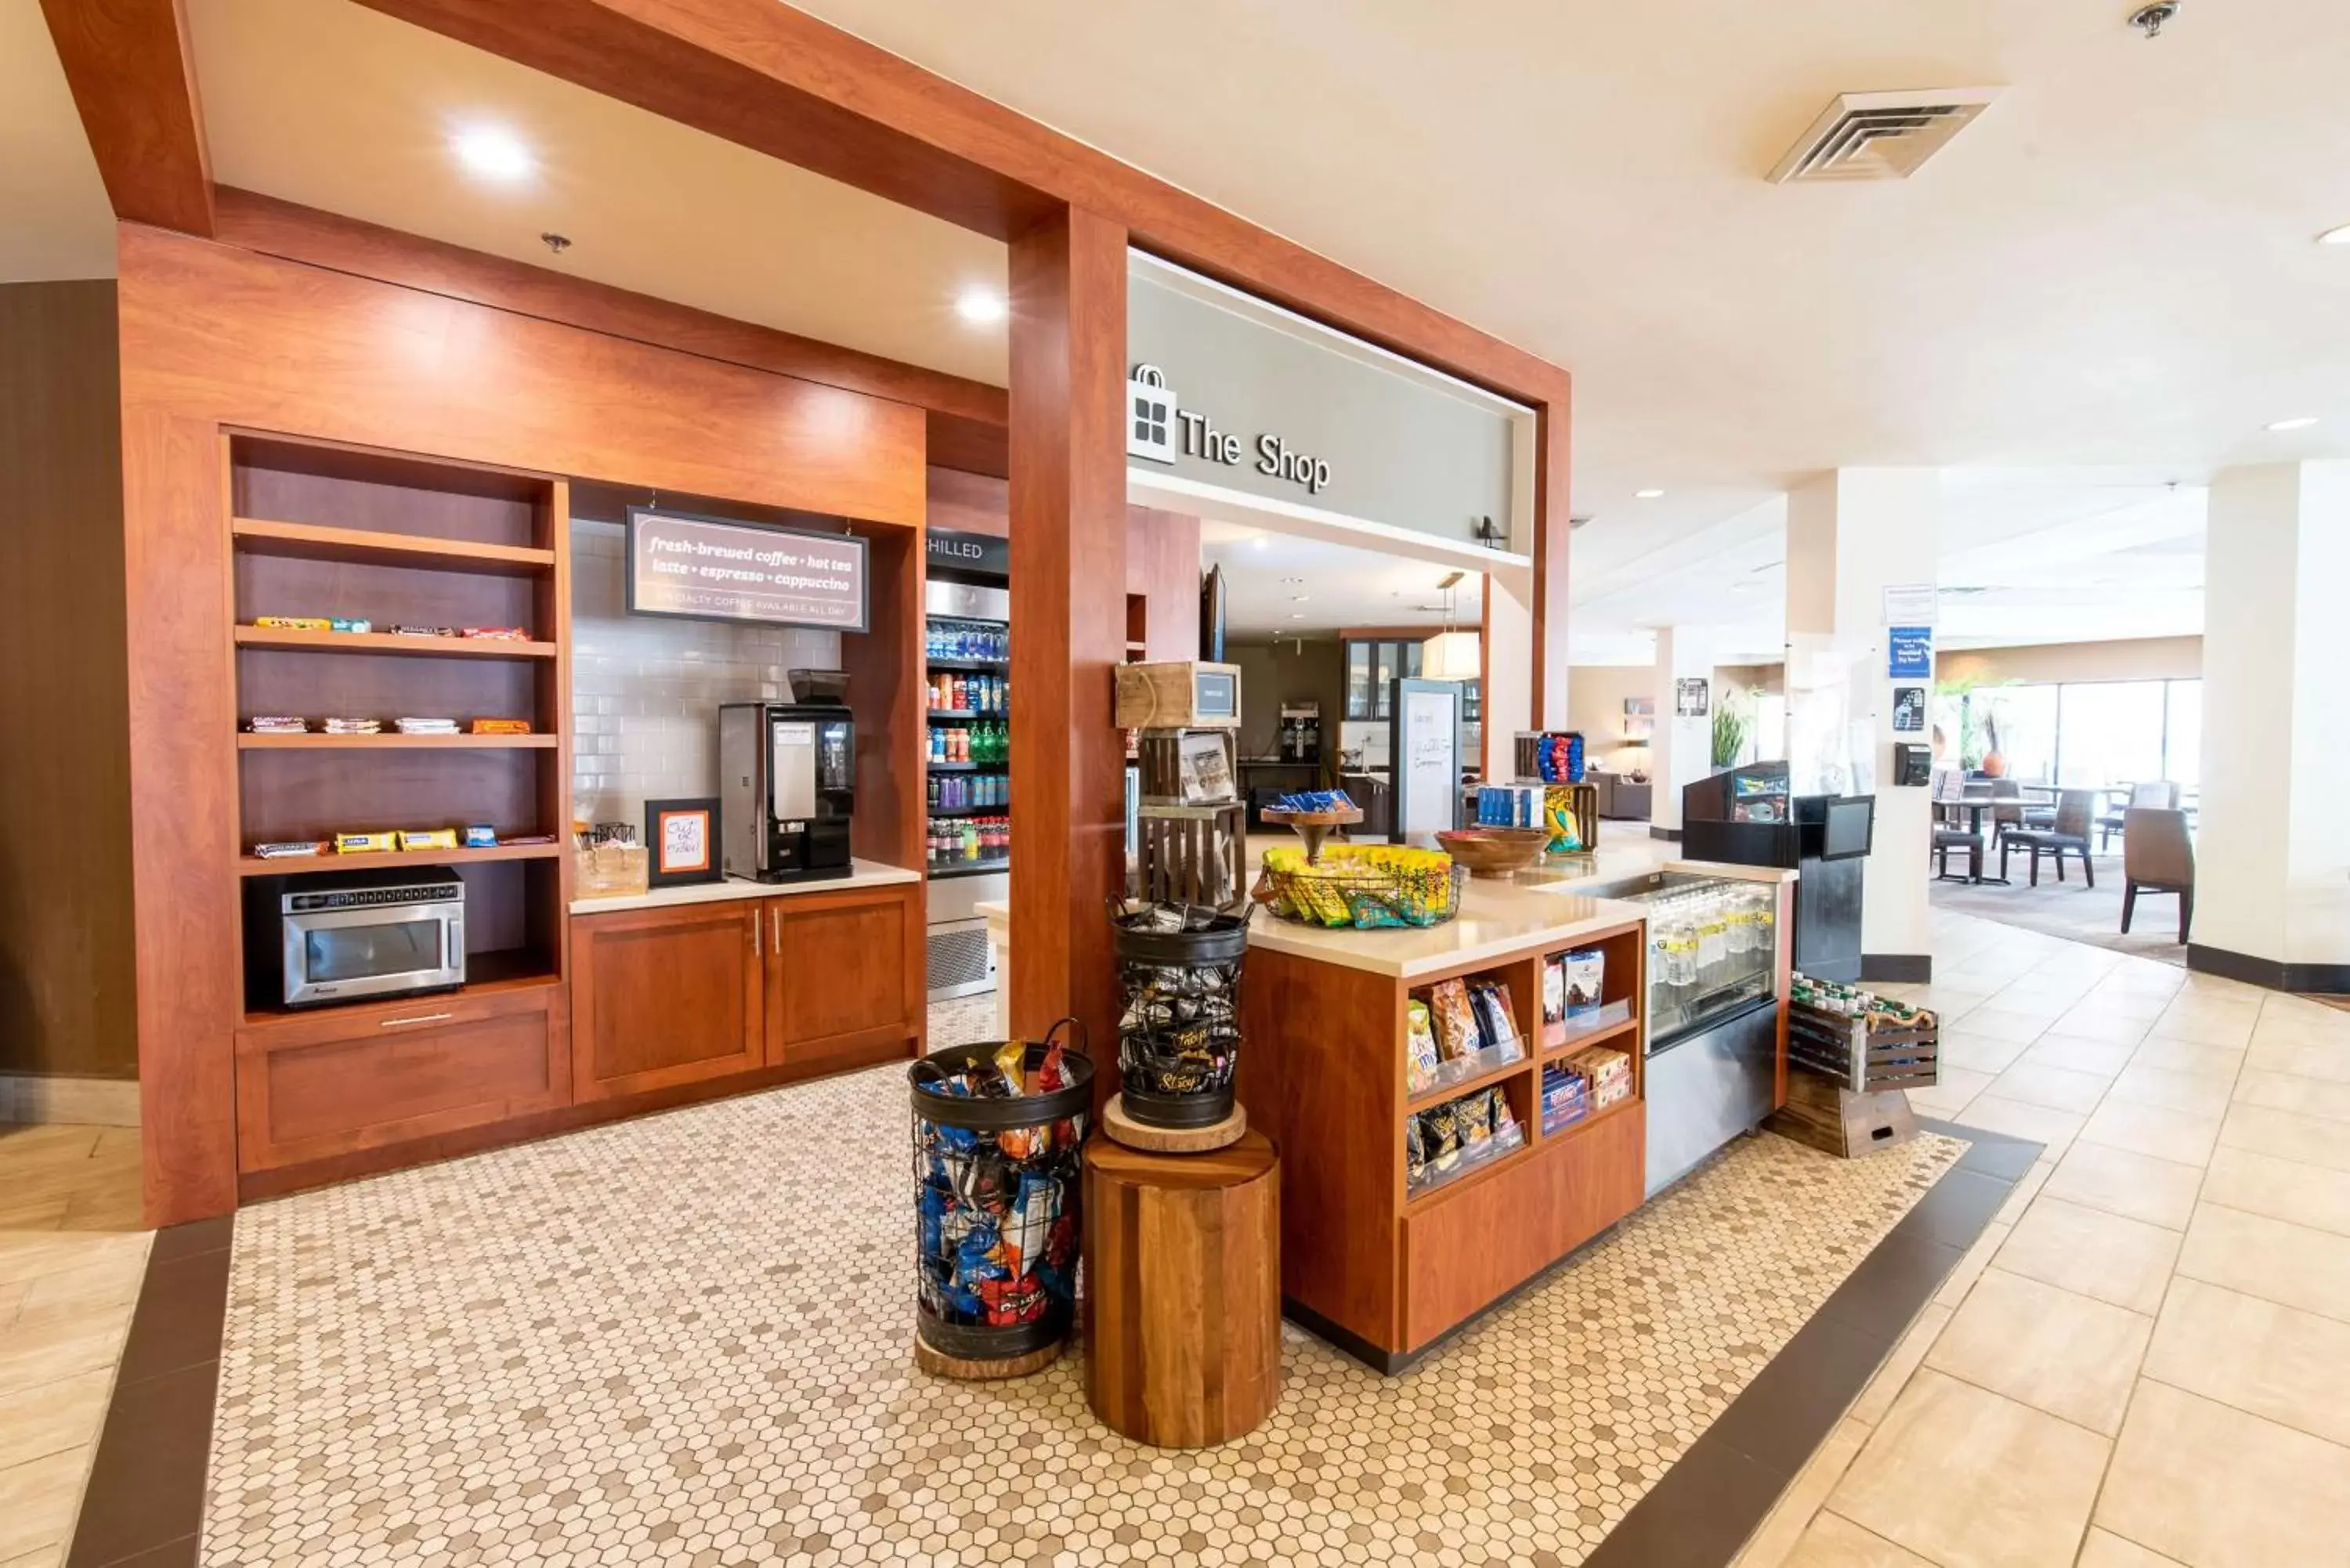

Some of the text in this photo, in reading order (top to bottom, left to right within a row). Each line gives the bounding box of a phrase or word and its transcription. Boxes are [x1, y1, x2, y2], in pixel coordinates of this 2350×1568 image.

[1177, 410, 1330, 494] The Shop
[646, 536, 852, 572] fresh-brewed coffee hot tea
[926, 538, 982, 558] HILLED
[653, 558, 850, 591] latte espresso cappuccino
